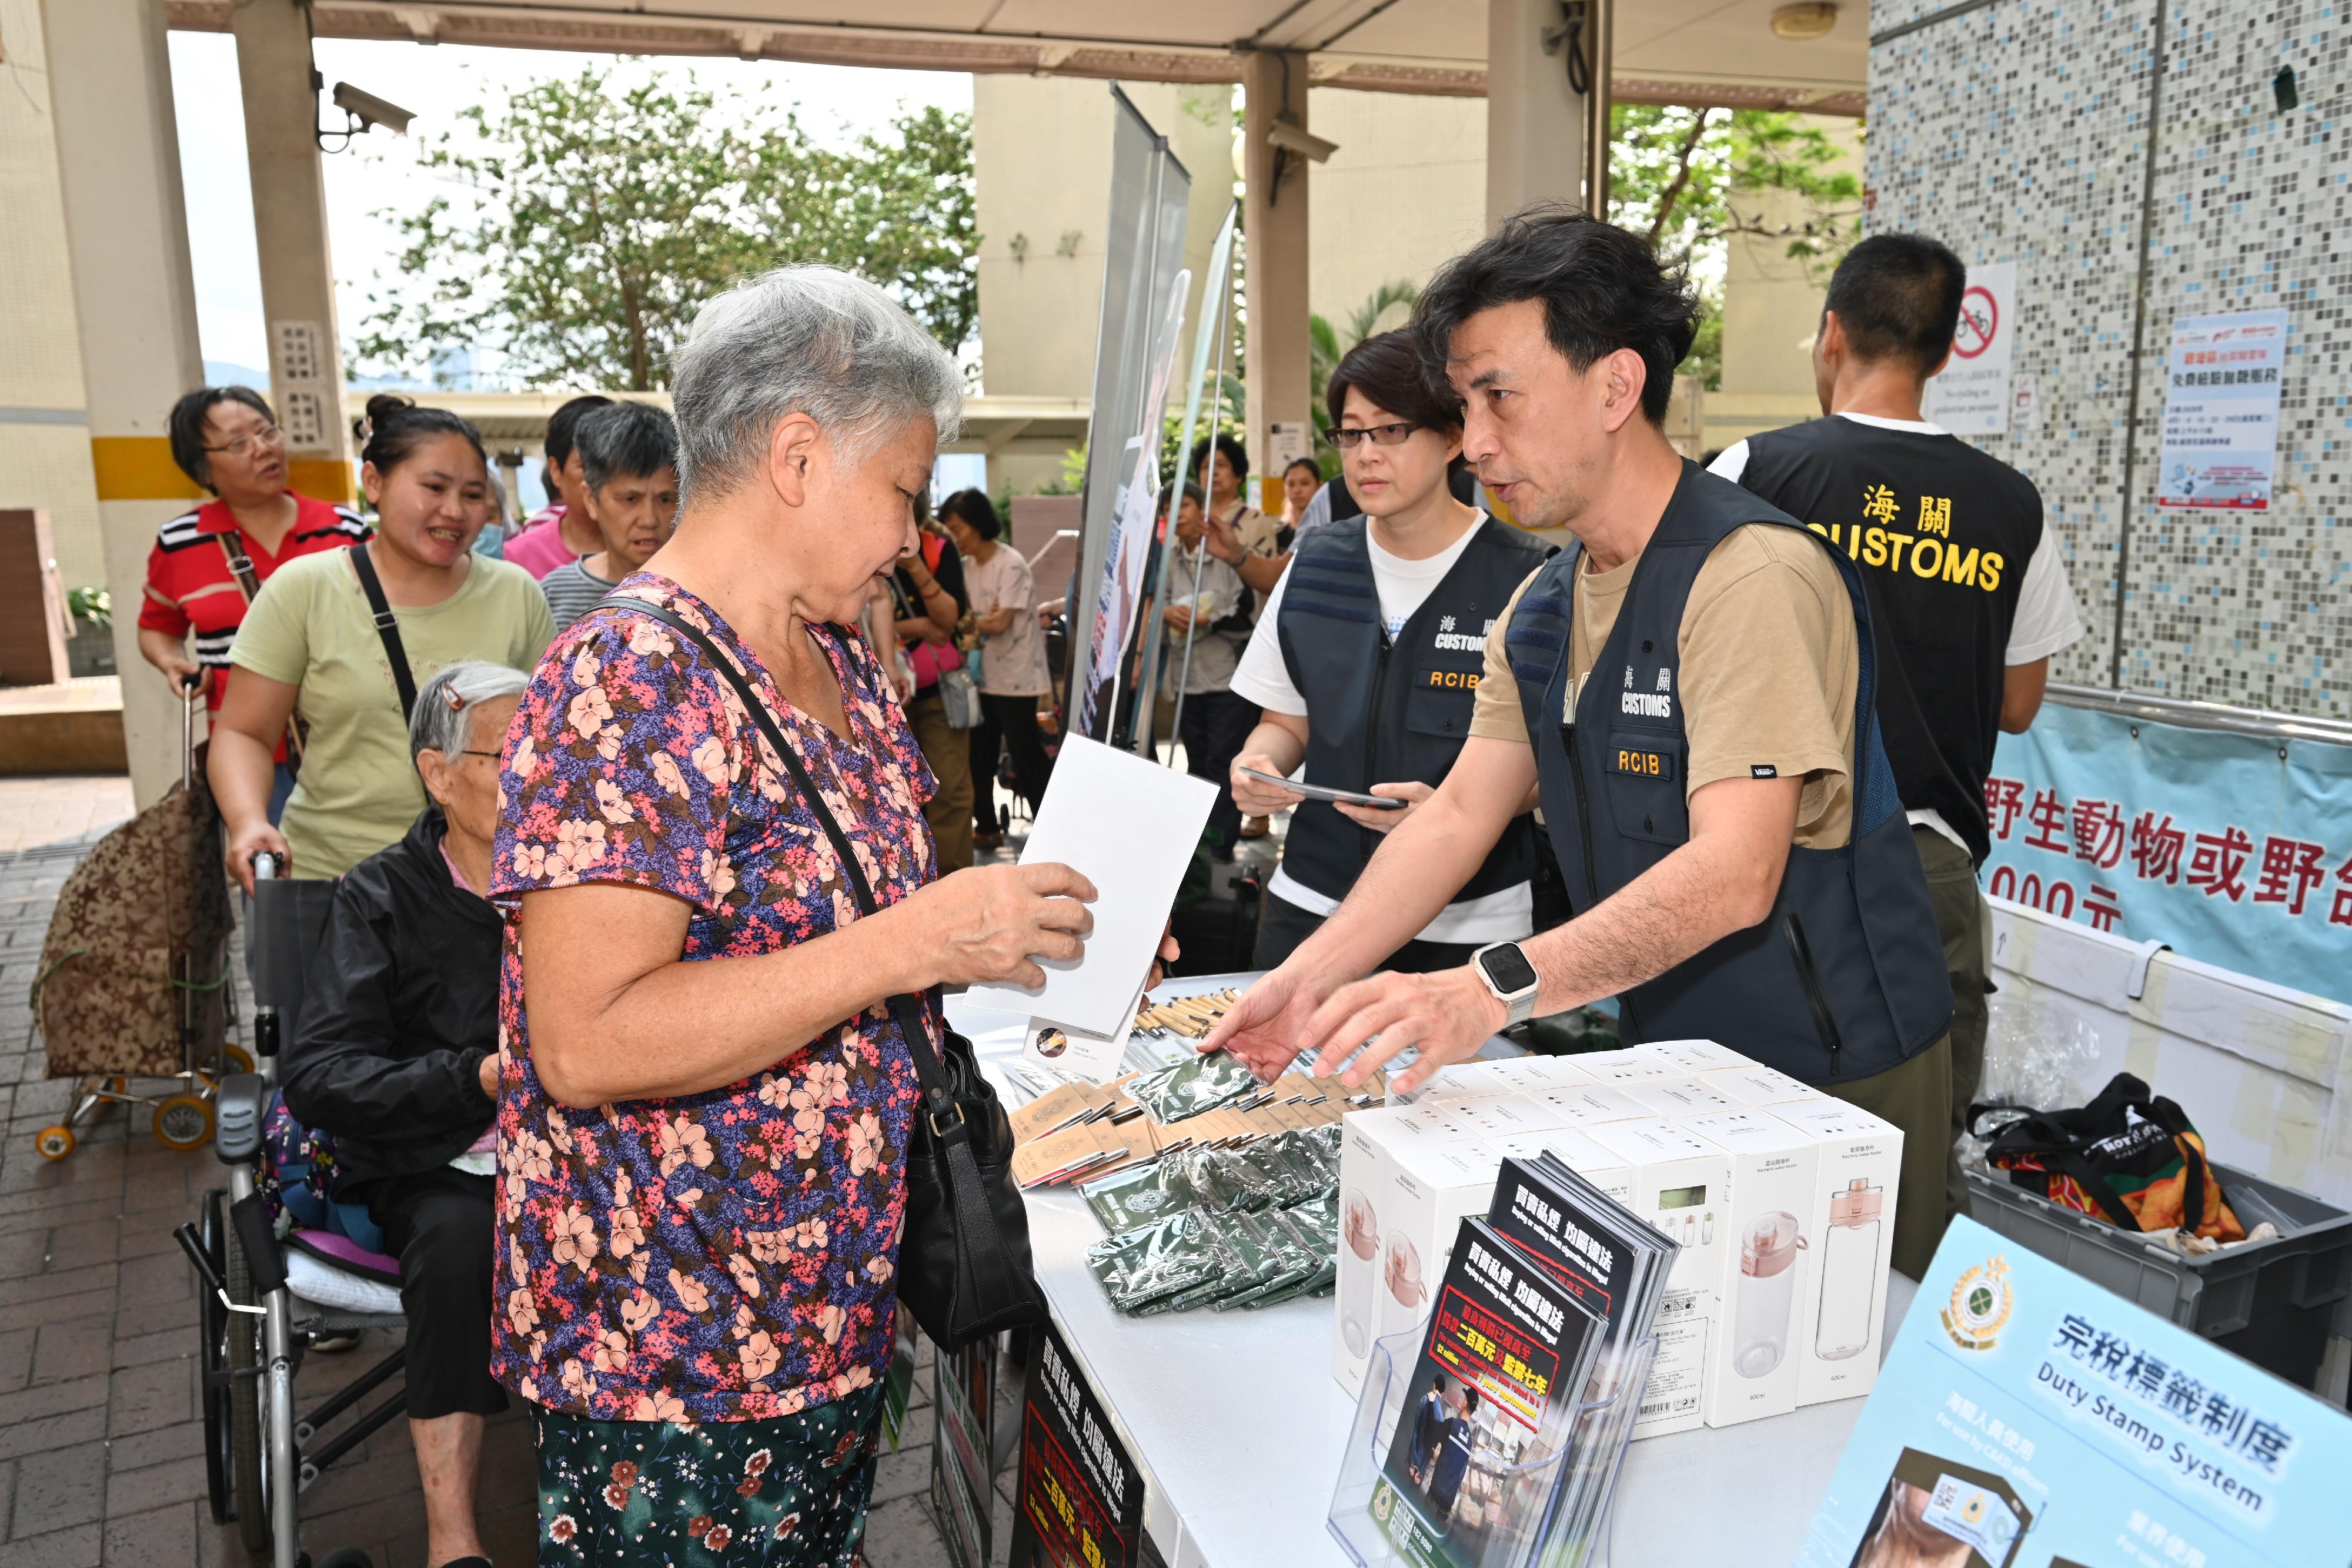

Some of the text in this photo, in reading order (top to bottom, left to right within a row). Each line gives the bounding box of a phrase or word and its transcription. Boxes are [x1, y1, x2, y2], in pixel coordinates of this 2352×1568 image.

[1863, 484, 1952, 539] 海關
[1435, 633, 1487, 651] CUSTOM
[1430, 671, 1479, 689] RCIB
[1622, 691, 1671, 718] CUSTOMS
[1623, 665, 1671, 693] 海關
[1618, 750, 1660, 775] RCIB
[1512, 1205, 1528, 1224] Buying
[1533, 1223, 1549, 1241] selling
[1561, 1245, 1586, 1269] cigarettes
[1563, 1221, 1613, 1273] 均屬違法
[1464, 1262, 1479, 1282] Buying
[1484, 1281, 1499, 1299] selling
[1510, 1303, 1535, 1328] cigarettes
[1514, 1279, 1565, 1333] 均屬違法
[1443, 1349, 1459, 1366] million
[1478, 1373, 1484, 1382] 7
[1043, 1335, 1125, 1504] 買賣私煙 均屬違法
[2037, 1361, 2263, 1512] Duty Stamp System
[1041, 1368, 1121, 1524] Buying or selling illicit cigarettes is illegal
[1420, 1536, 1432, 1553] 8080
